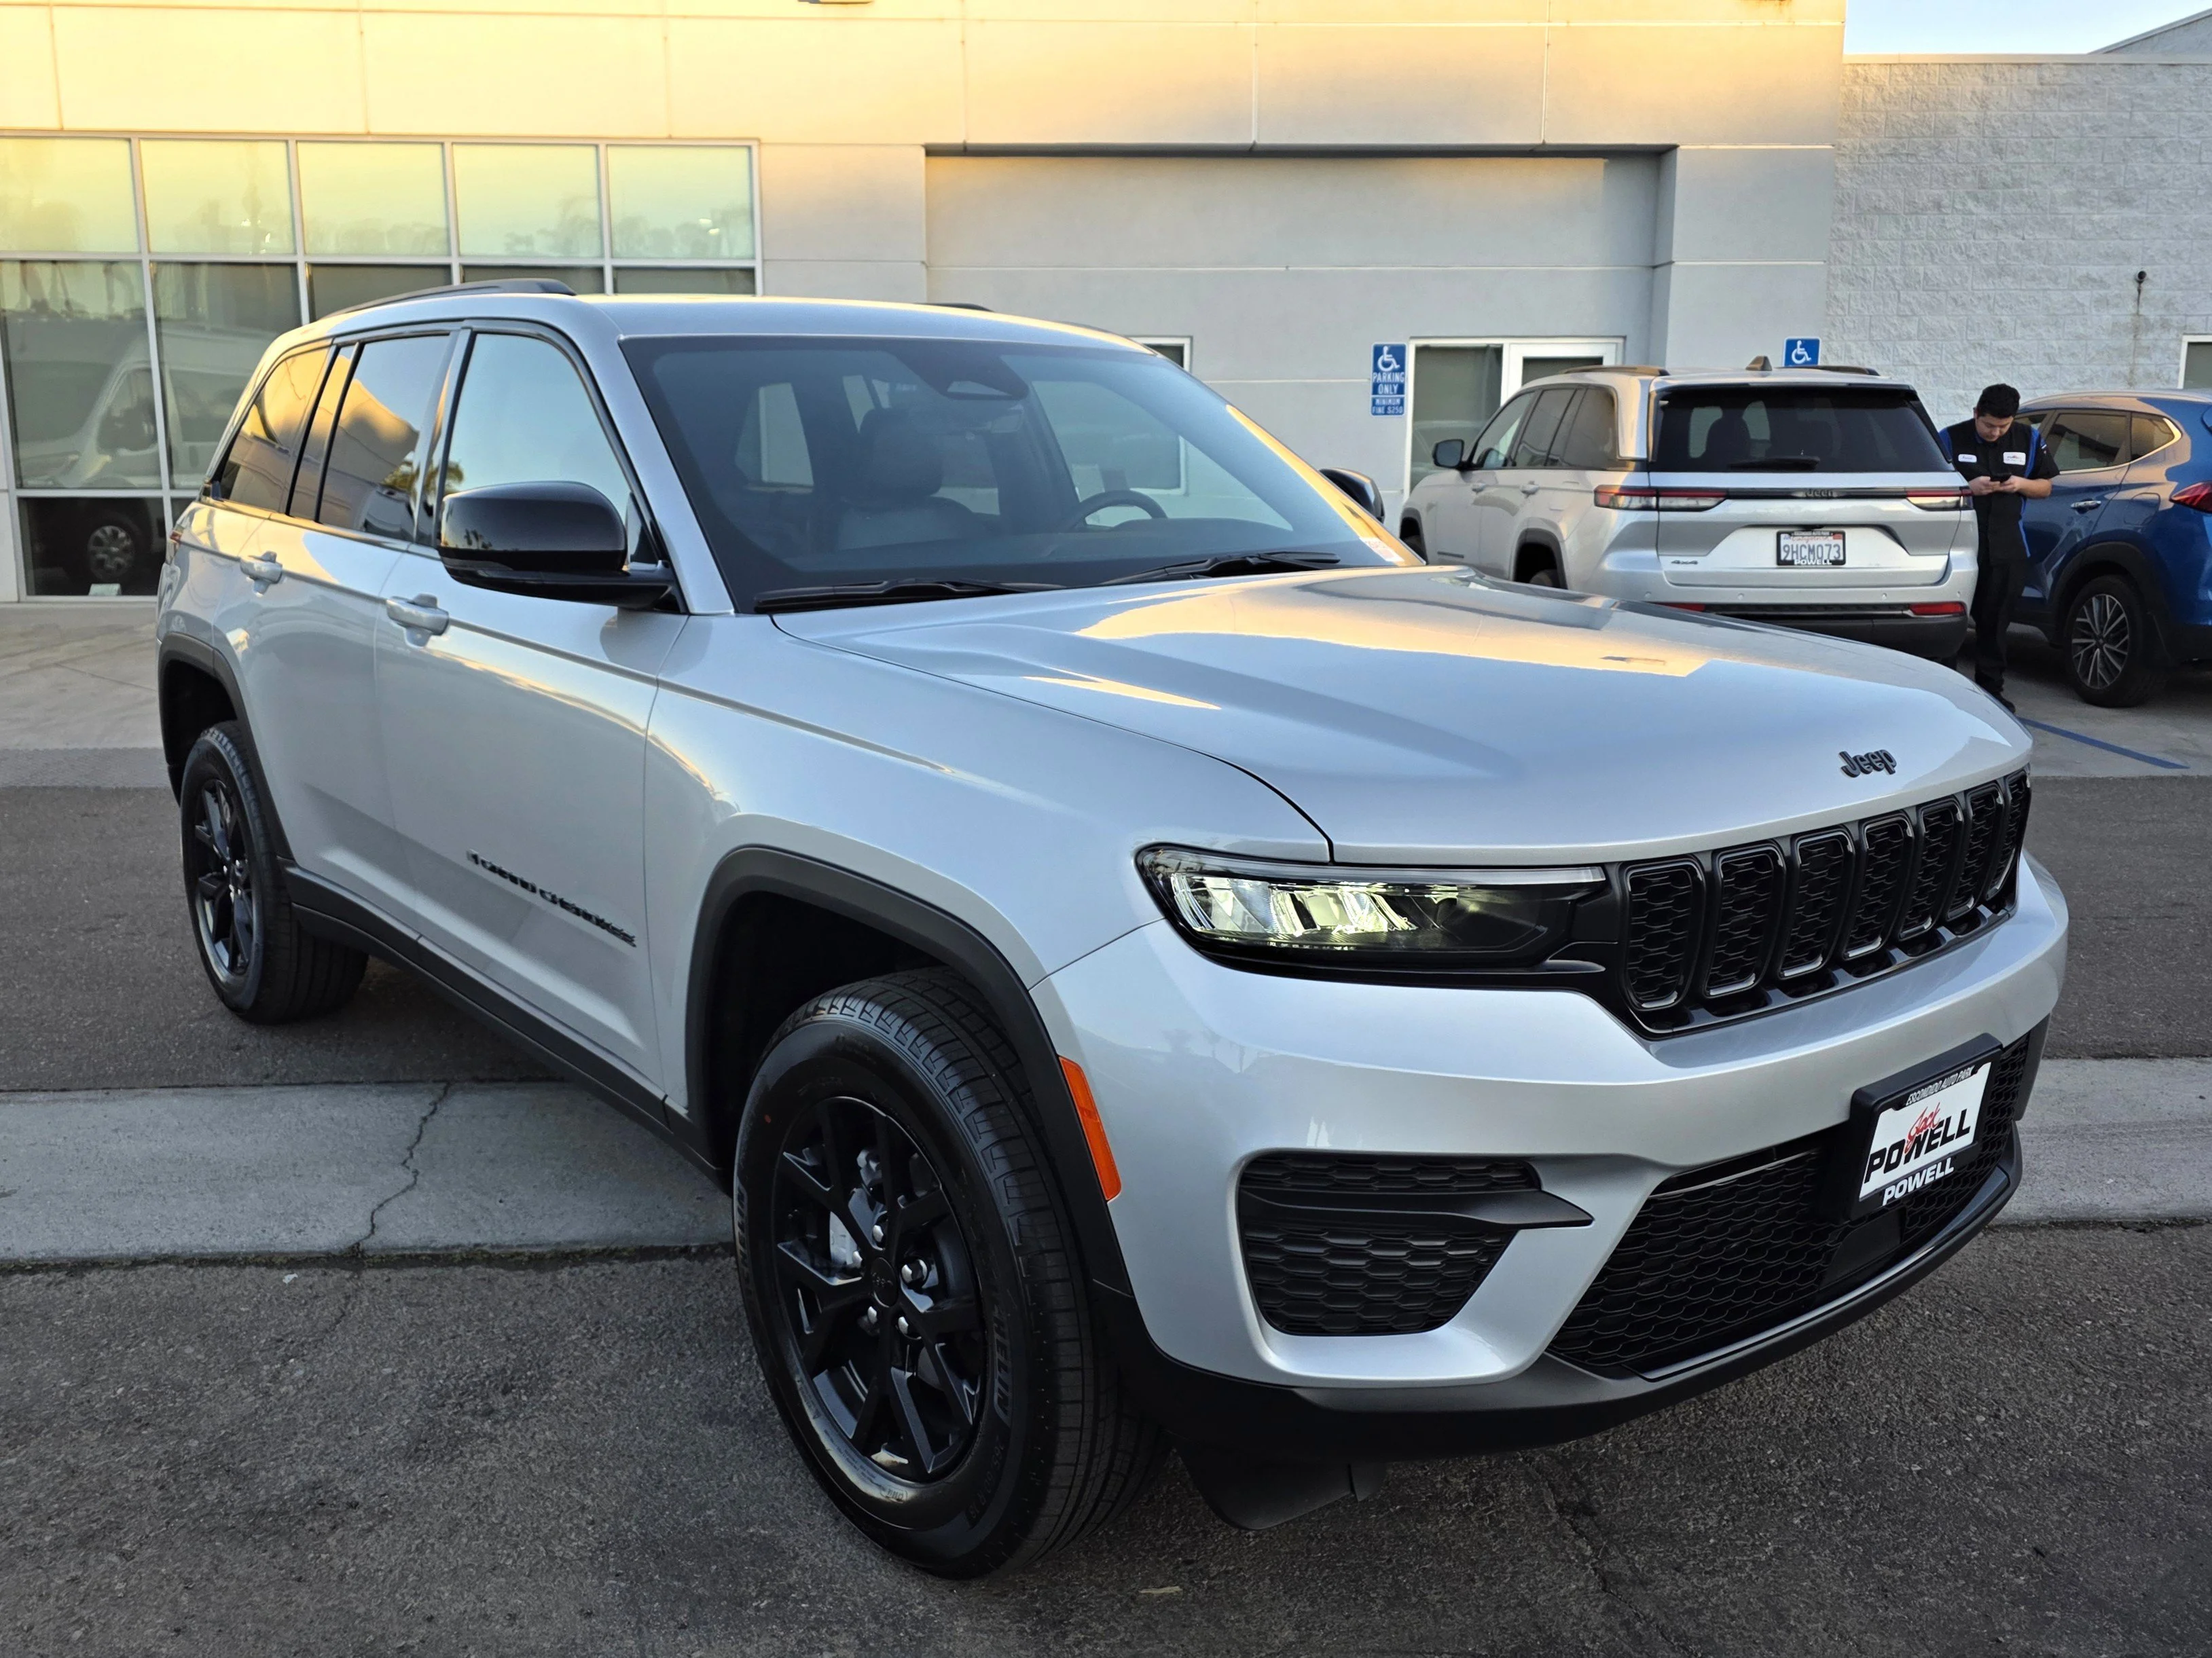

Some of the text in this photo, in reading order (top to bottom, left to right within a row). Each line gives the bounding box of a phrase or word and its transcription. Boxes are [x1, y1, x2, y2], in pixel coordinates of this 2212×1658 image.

[1373, 372, 1404, 382] PARKING
[1378, 384, 1398, 394] ONLY
[1783, 544, 1841, 560] 9HCM073
[1838, 750, 1897, 778] Jeep
[1864, 1109, 1971, 1184] POWELL
[1883, 1158, 1954, 1206] POWELL
